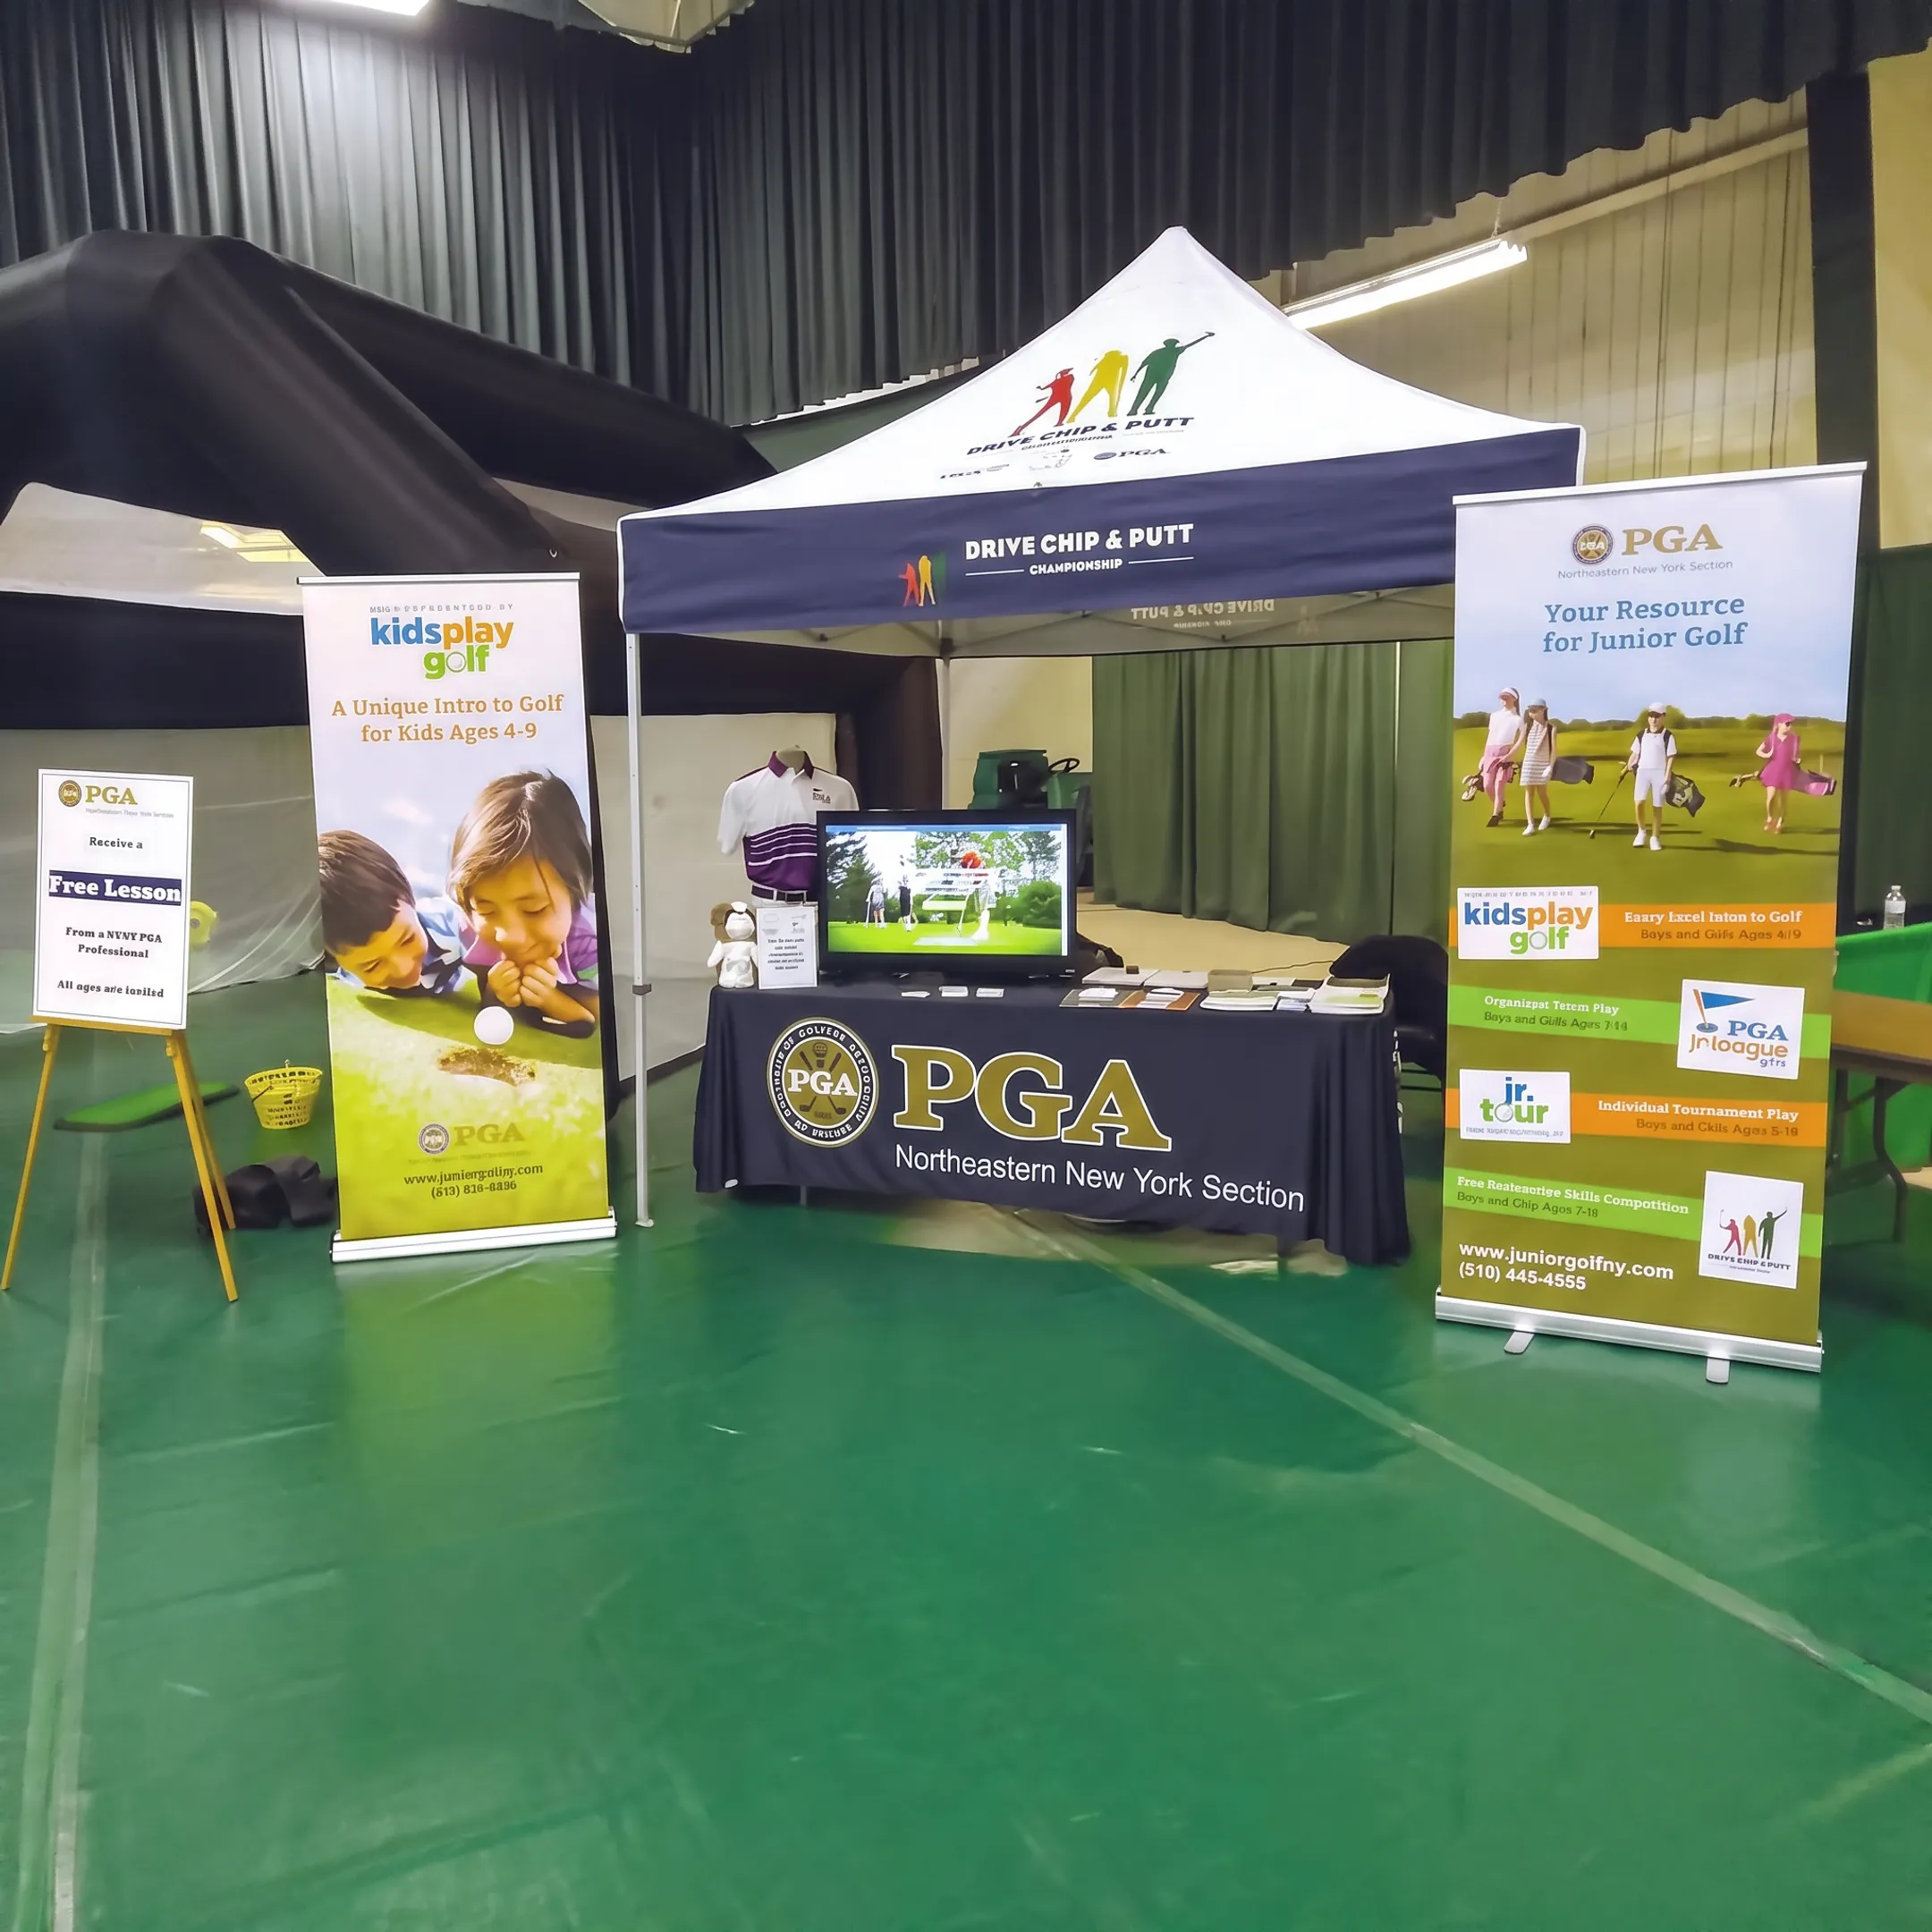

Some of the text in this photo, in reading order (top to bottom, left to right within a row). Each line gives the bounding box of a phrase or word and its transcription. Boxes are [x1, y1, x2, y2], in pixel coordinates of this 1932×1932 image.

[966, 435, 1038, 455] DRIVE
[1040, 425, 1097, 441] CHIP
[1101, 423, 1117, 433] &
[1125, 417, 1195, 430] PUTT
[966, 523, 1195, 560] DRIVE CHIP & PUTT
[1621, 523, 1724, 556] PGA
[1029, 558, 1123, 576] CHAMPIONSHIP
[1557, 559, 1734, 580] Northeastern New York Section
[1545, 597, 1745, 623] Your Resource
[1543, 622, 1749, 654] for Junior Golf
[423, 644, 490, 680] golf
[331, 693, 564, 719] A Unique Intro to Golf
[361, 722, 538, 745] for Kids Ages 4-9
[85, 785, 138, 806] PGA
[89, 837, 143, 850] Receive a
[49, 875, 182, 902] Free Lesson
[1750, 911, 1767, 923] to
[1769, 911, 1803, 923] Golf
[65, 927, 96, 939] From
[140, 933, 163, 944] PGA
[1510, 926, 1570, 955] golf
[1676, 929, 1700, 940] and
[78, 944, 149, 959] Professional
[57, 980, 73, 990] All
[1515, 1014, 1537, 1025] and
[1727, 1020, 1789, 1042] PGA
[787, 1068, 858, 1097] PGA
[1505, 1076, 1534, 1106] jr.
[891, 1044, 1173, 1152] PGA
[1479, 1098, 1549, 1124] tour
[1597, 1100, 1800, 1123] Individual Tournament Play
[453, 1122, 526, 1148] PGA
[1671, 1122, 1695, 1131] and
[894, 1143, 1305, 1213] Northeastern New York Section
[1457, 1175, 1485, 1189] Free
[1563, 1188, 1601, 1204] Skills
[1487, 1196, 1509, 1208] and
[1513, 1199, 1539, 1212] Chip
[1459, 1261, 1587, 1291] (510) 445-4555
